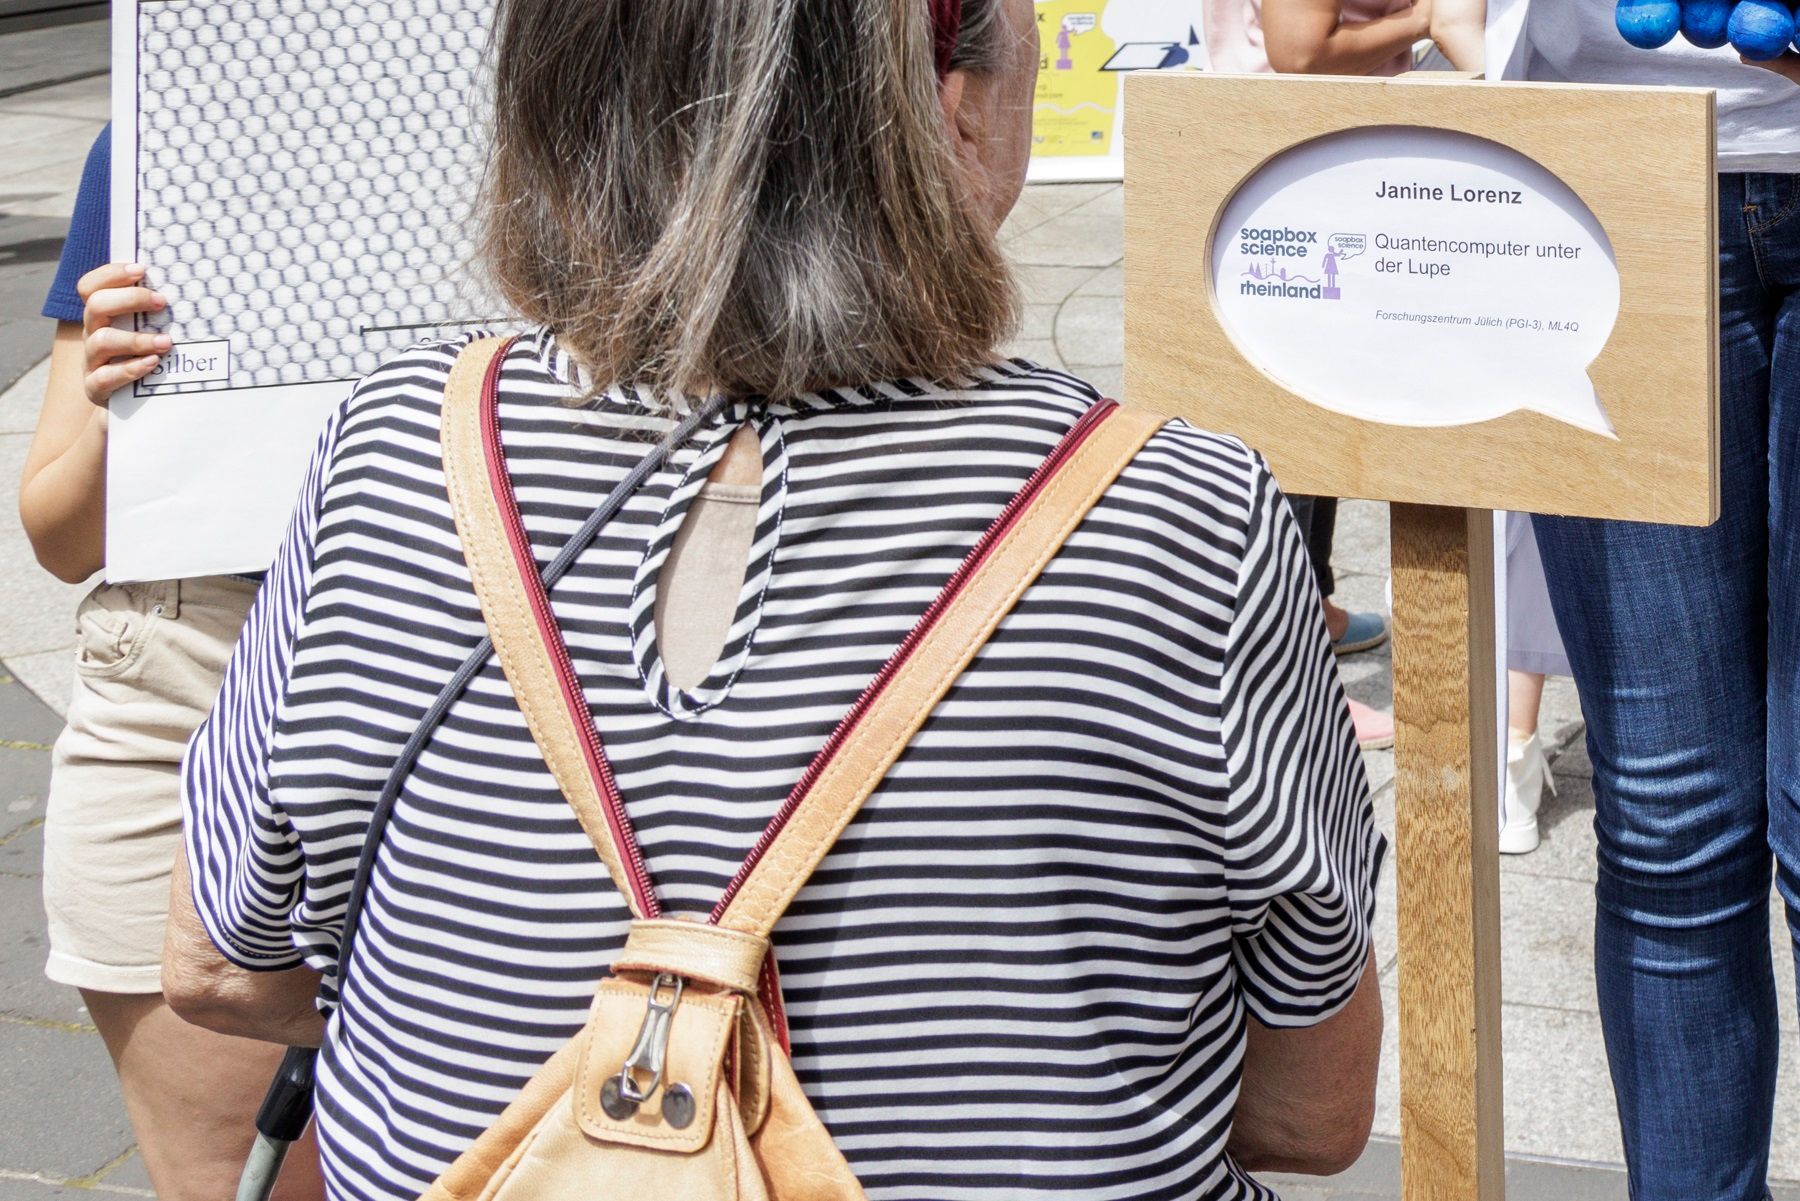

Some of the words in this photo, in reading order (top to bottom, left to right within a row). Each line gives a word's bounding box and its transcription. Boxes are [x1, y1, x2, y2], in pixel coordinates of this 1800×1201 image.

[1376, 181, 1444, 200] Janine
[1451, 184, 1523, 204] Lorenz
[1240, 227, 1317, 244] soapbox
[1375, 233, 1530, 258] Quantencomputer
[1536, 243, 1581, 259] unter
[1240, 240, 1307, 257] science
[1375, 257, 1402, 273] der
[1408, 258, 1451, 278] Lupe
[1240, 280, 1321, 299] rheinland
[1375, 309, 1472, 326] Forschungszentrum
[1475, 314, 1502, 327] Jülich
[1505, 317, 1545, 332] (PGI-3),
[1548, 320, 1579, 332] ML4Q
